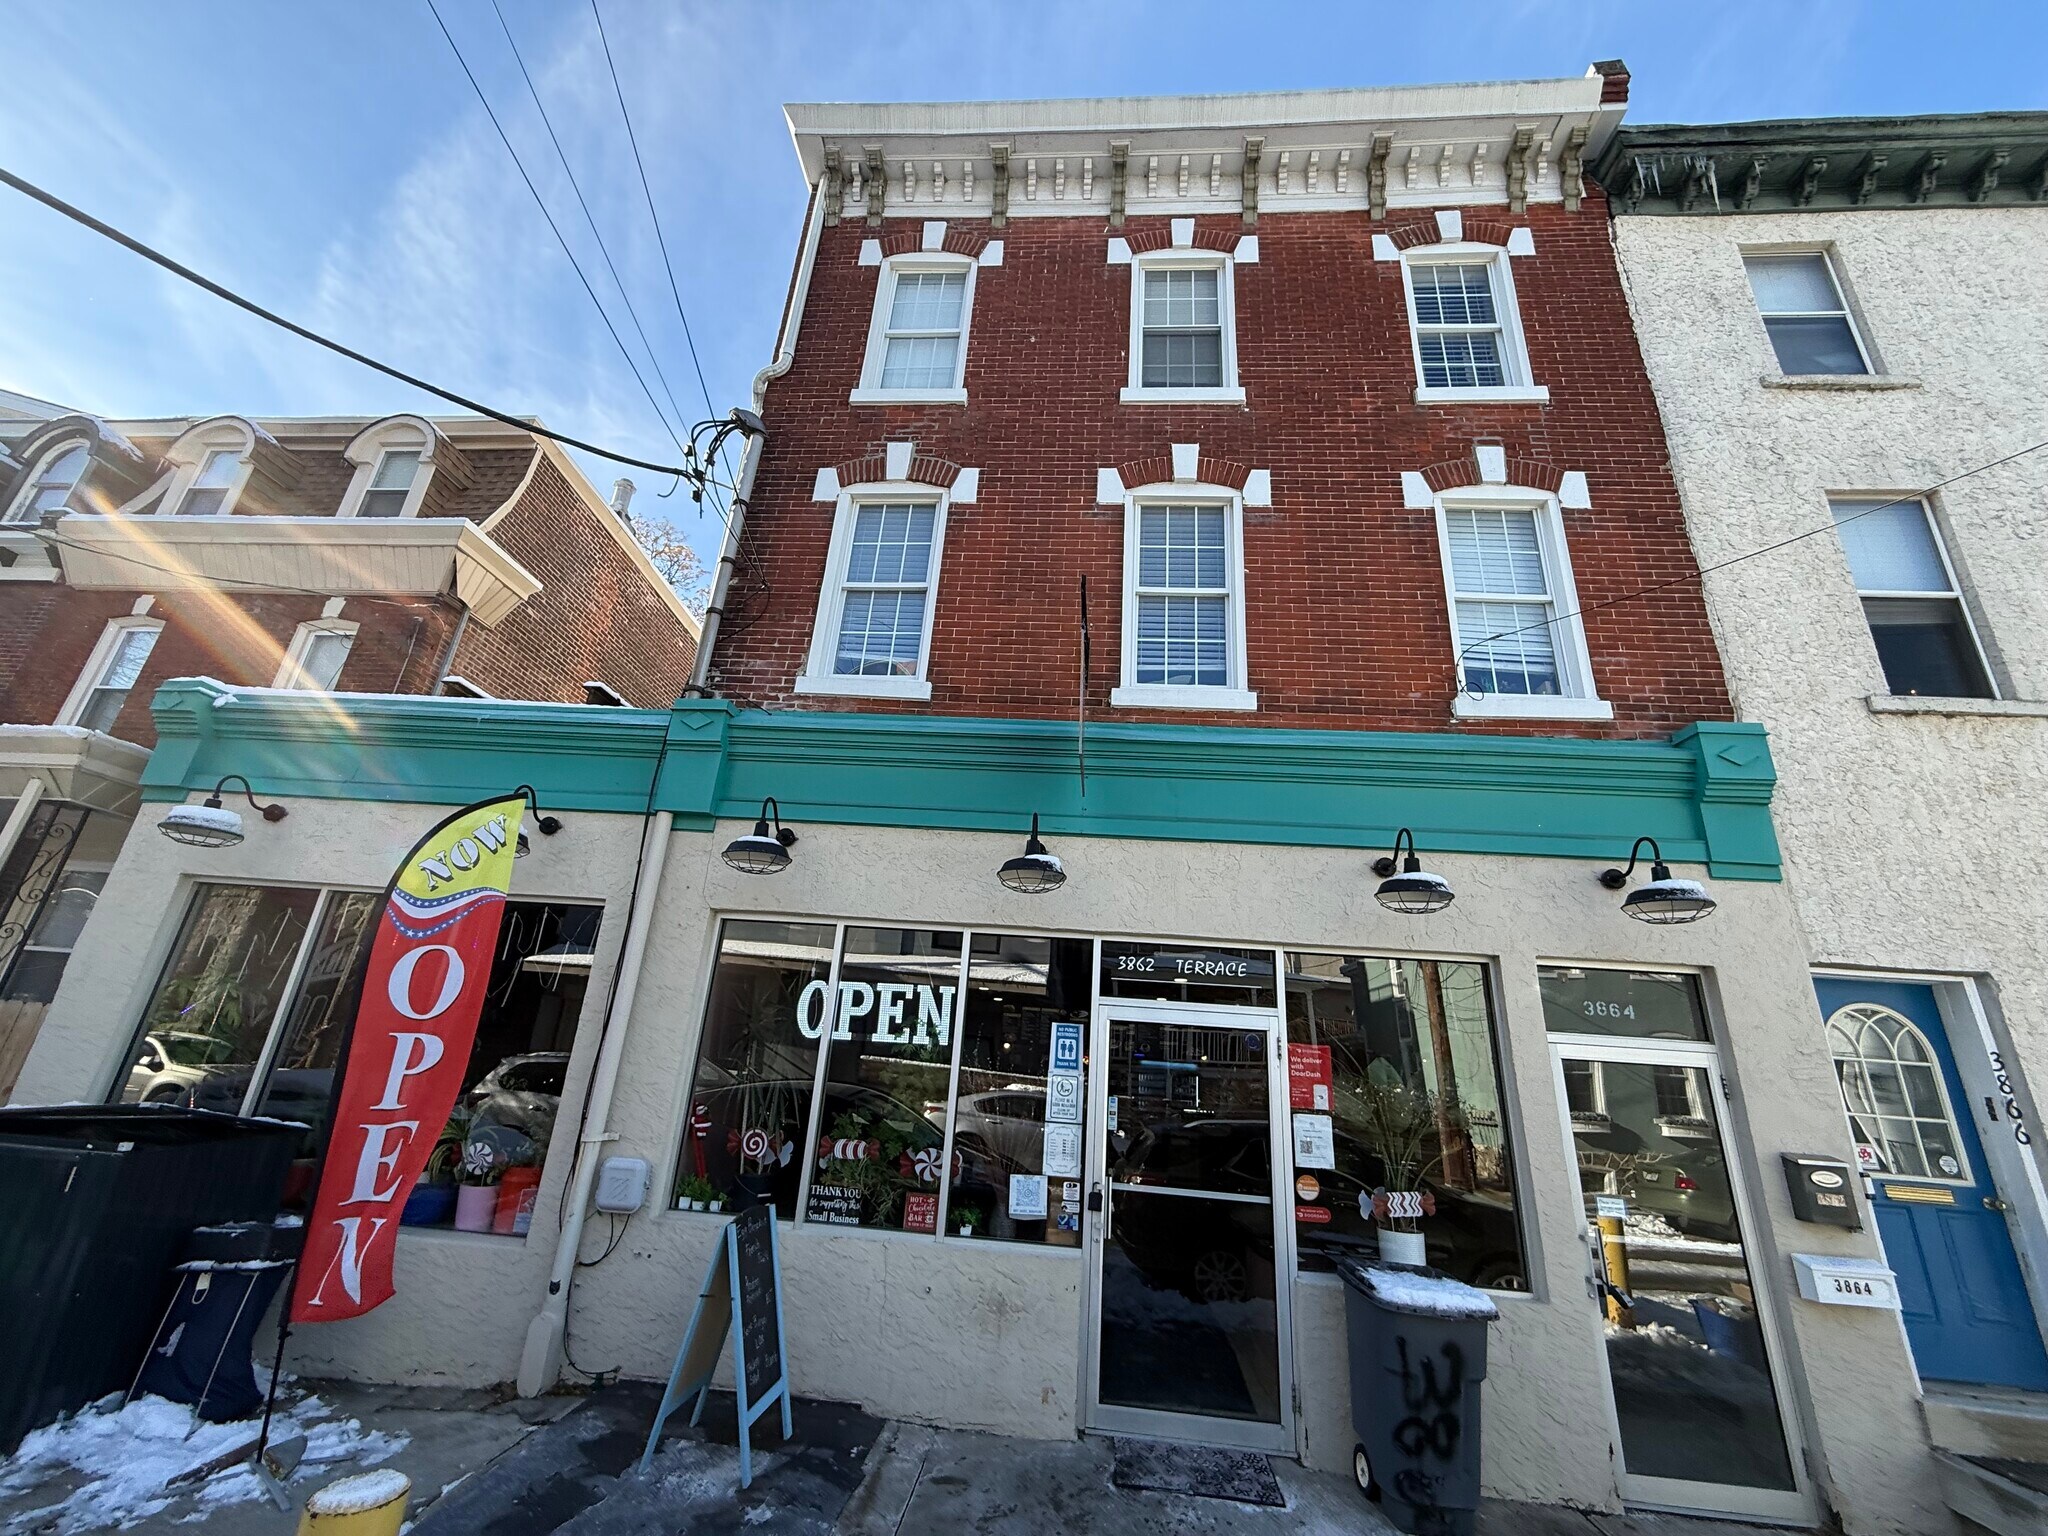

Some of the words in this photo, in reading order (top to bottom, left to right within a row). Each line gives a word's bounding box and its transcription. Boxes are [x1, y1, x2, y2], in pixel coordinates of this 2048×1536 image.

[418, 813, 508, 892] NOW
[1117, 956, 1155, 972] 3862
[1175, 959, 1247, 977] TERRACE
[797, 979, 956, 1046] OPEN
[1583, 1000, 1635, 1020] 3864
[1302, 1056, 1323, 1064] deliver
[1291, 1069, 1322, 1078] DoorDash
[1990, 1051, 2031, 1145] 3866
[308, 944, 464, 1306] OPEN
[811, 1185, 842, 1197] THANK
[843, 1187, 861, 1199] YOU
[808, 1210, 828, 1222] Small
[829, 1211, 859, 1225] Business
[907, 1213, 923, 1222] BAR
[1834, 1279, 1872, 1296] 3864
